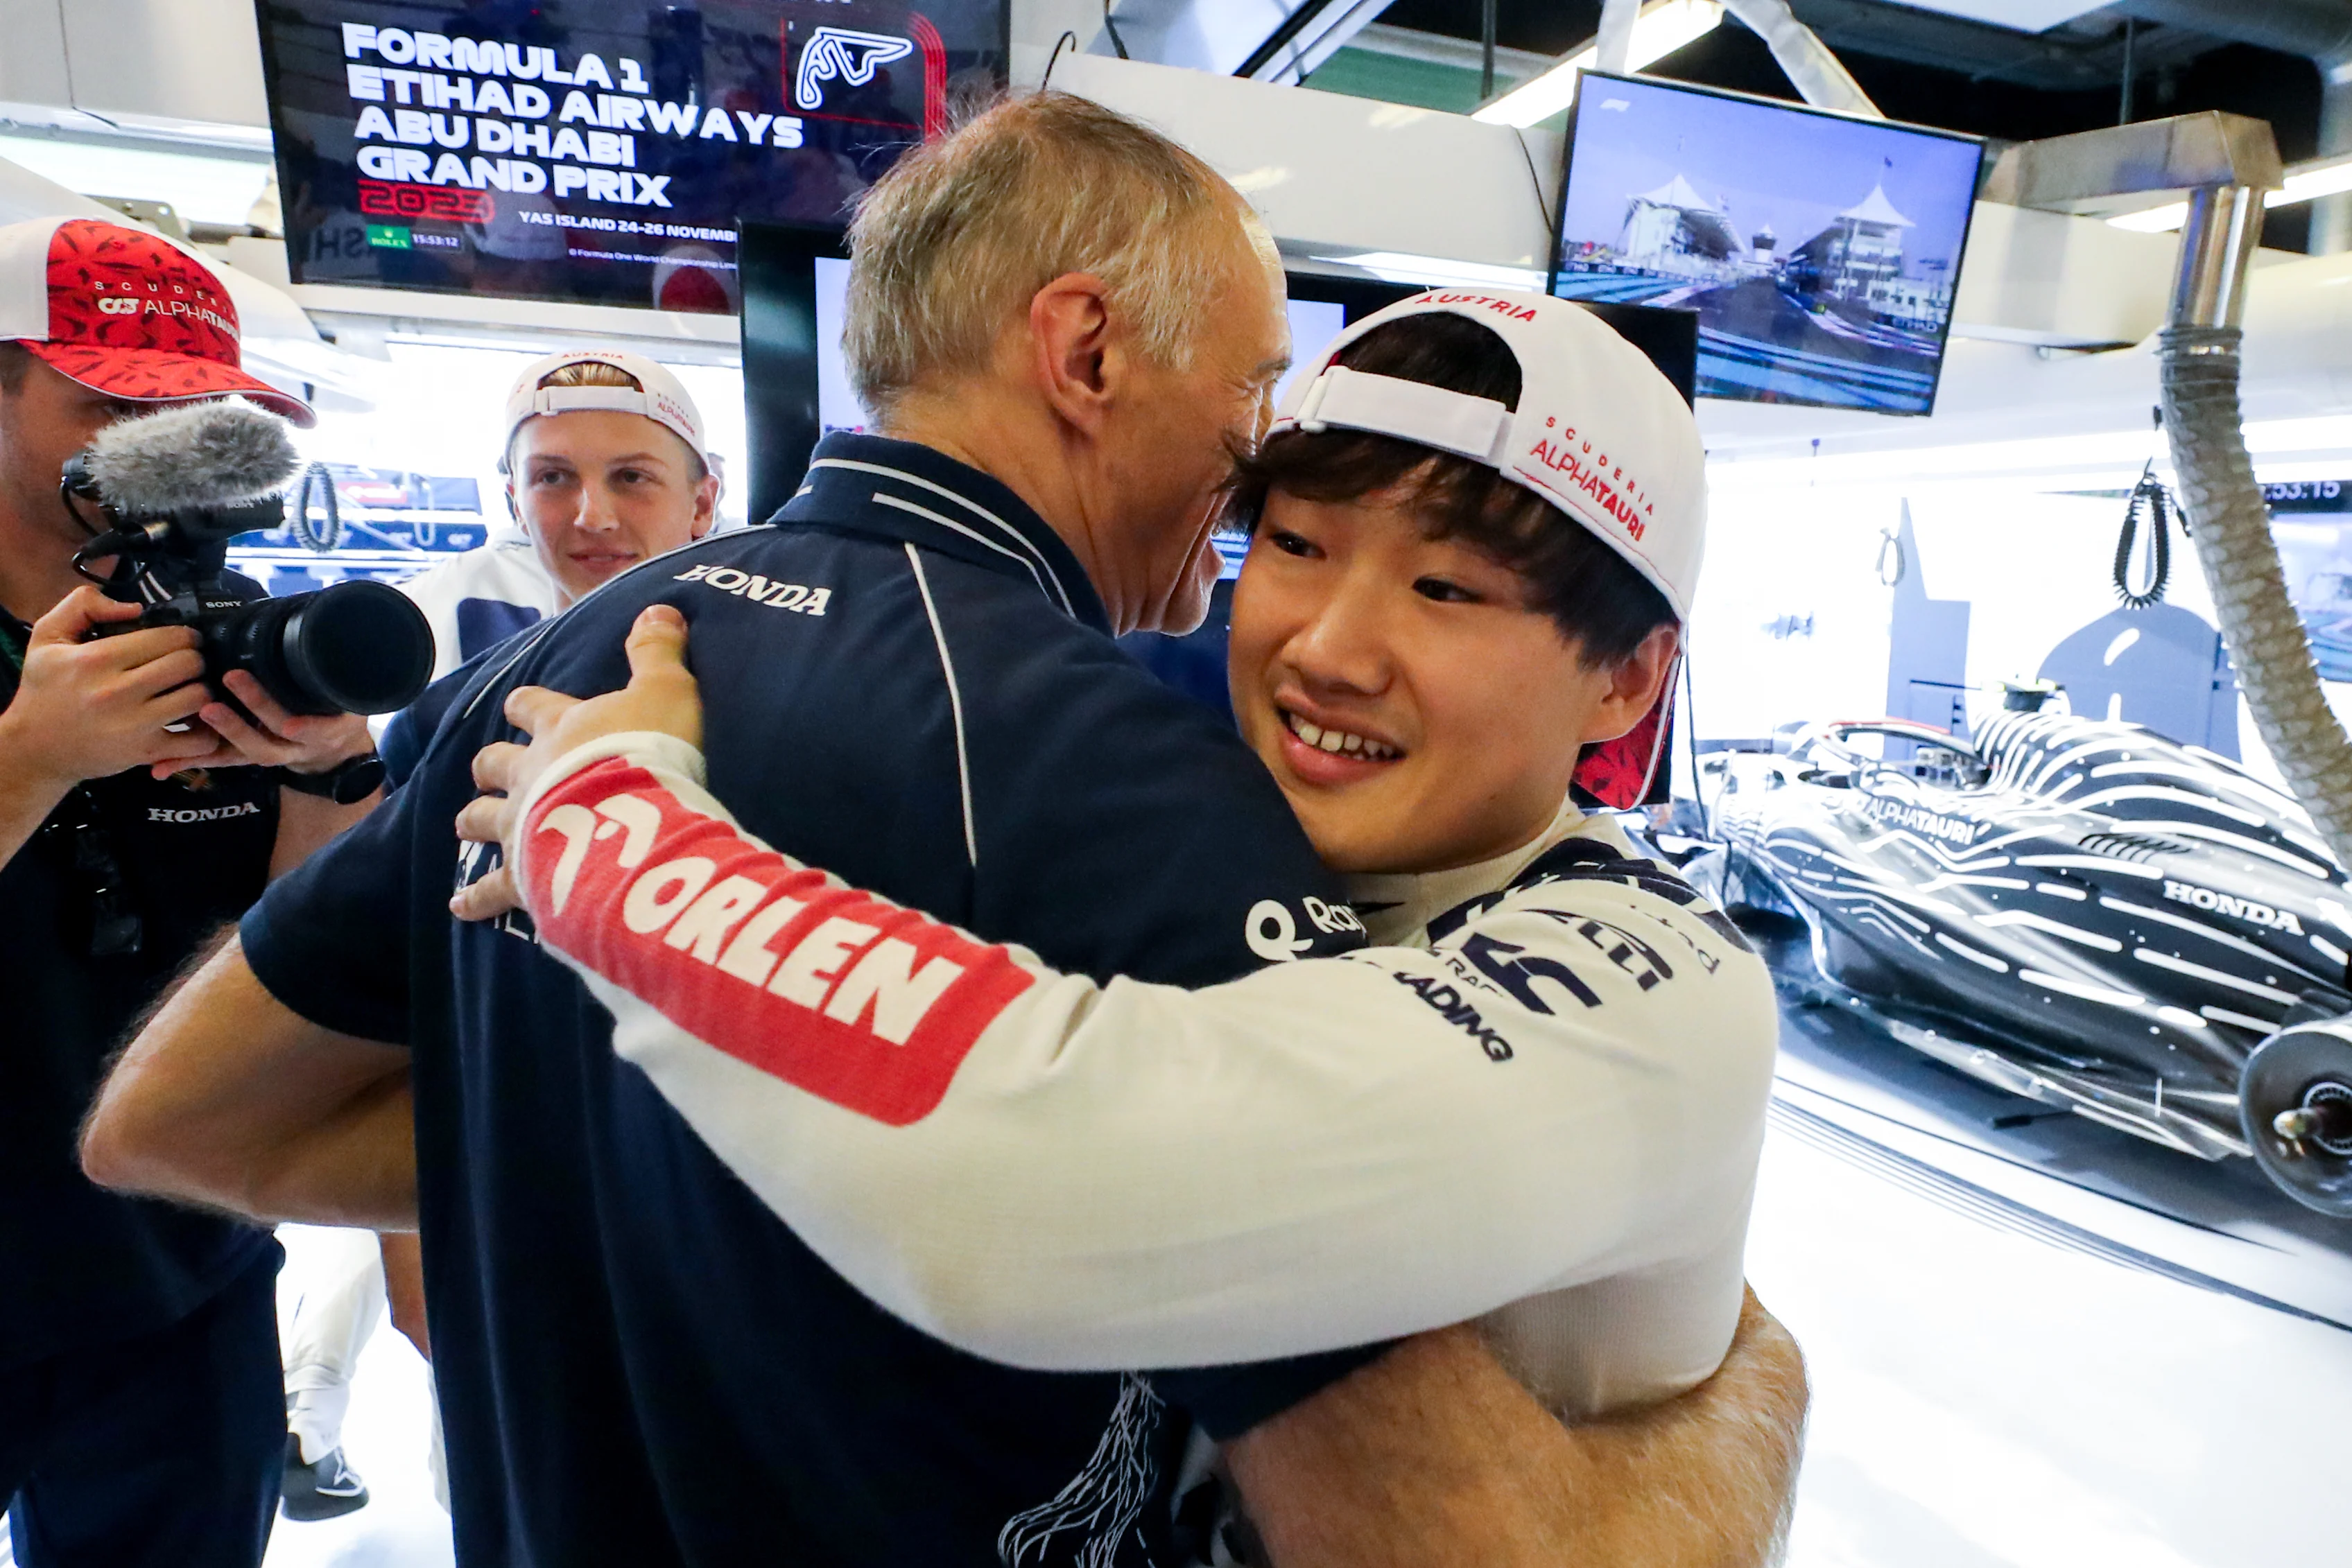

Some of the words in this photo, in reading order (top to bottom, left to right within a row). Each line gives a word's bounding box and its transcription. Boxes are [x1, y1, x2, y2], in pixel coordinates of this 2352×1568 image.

[342, 22, 614, 90] FORMULA
[619, 58, 650, 94] 1
[347, 64, 551, 119] ETIHAD
[559, 90, 804, 148] AIRWAYS
[354, 105, 469, 148] ABU
[476, 118, 636, 167] DHABI
[356, 146, 547, 193] GRAND
[553, 164, 673, 207] PRIX
[357, 179, 494, 223] 2023
[371, 237, 408, 248] ROLEX
[519, 211, 553, 226] YAS
[555, 214, 616, 232] ISLAND
[618, 220, 664, 236] 24-26
[578, 249, 614, 259] Formula
[614, 252, 632, 261] One
[633, 254, 659, 264] World
[1415, 293, 1537, 323] AUSTRIA
[1530, 439, 1645, 542] ALPHATAURI
[1546, 416, 1653, 516] SCUDERIA
[2264, 480, 2342, 500] :53:15
[205, 600, 242, 609] SONY
[673, 564, 831, 616] HONDA
[148, 801, 261, 824] HONDA
[1866, 798, 1976, 846] ALPHATAURI
[2163, 880, 2306, 936] HONDA
[623, 855, 965, 1046] ORLEN
